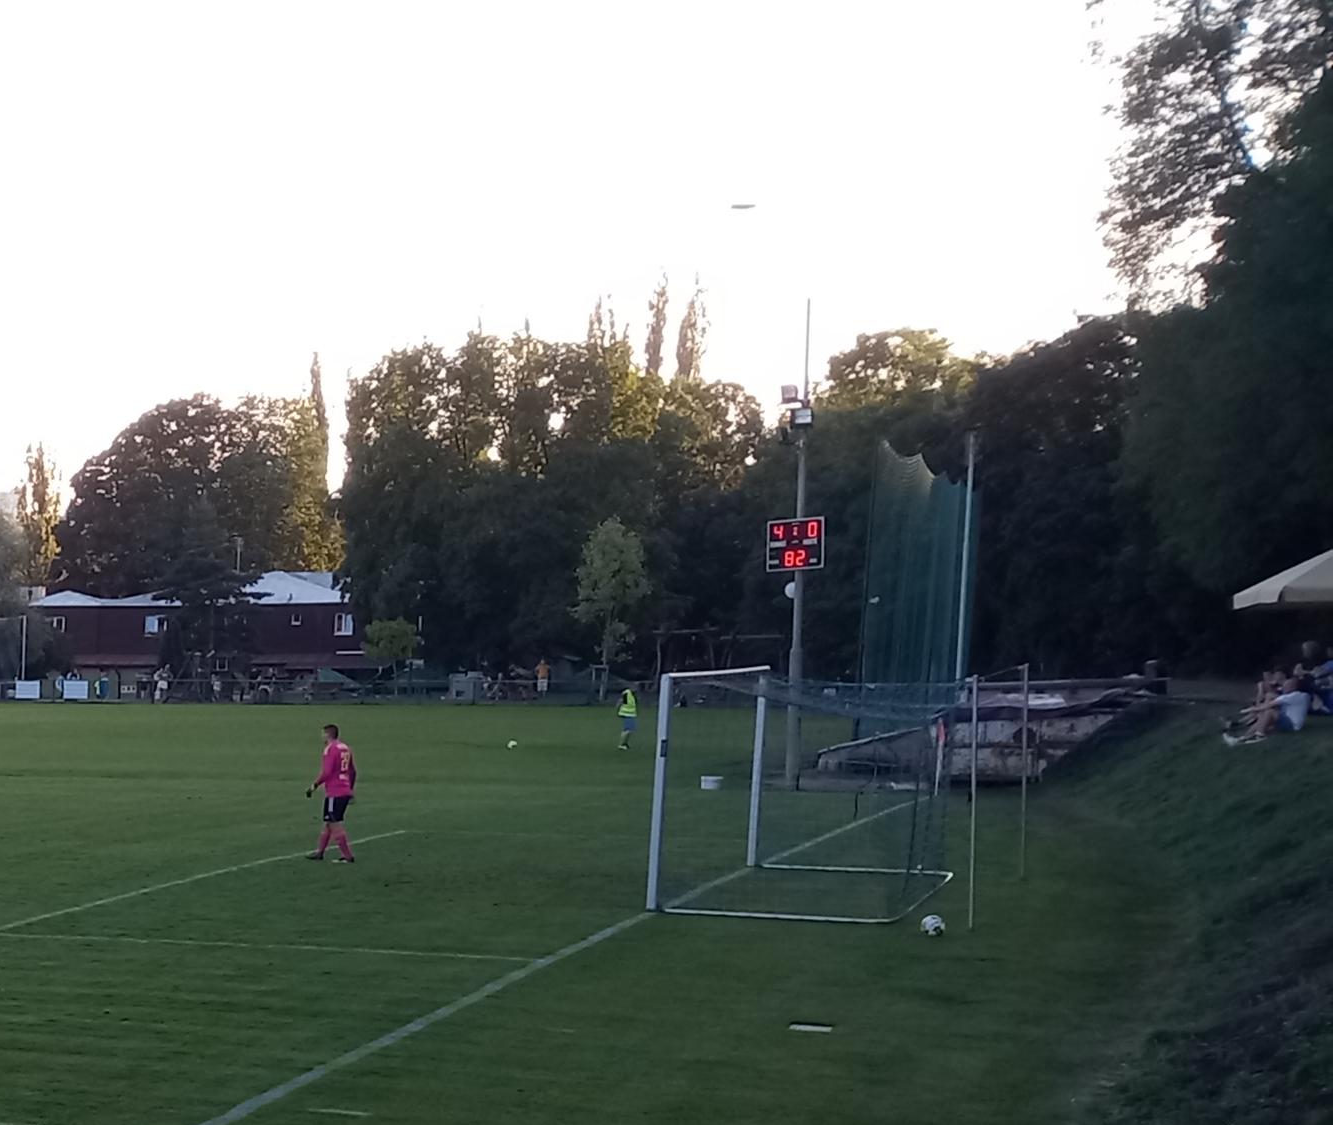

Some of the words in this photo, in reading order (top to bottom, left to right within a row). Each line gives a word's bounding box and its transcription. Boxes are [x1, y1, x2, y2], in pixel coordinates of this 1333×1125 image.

[773, 525, 784, 539] 4
[808, 522, 818, 537] 0
[784, 549, 806, 567] 82
